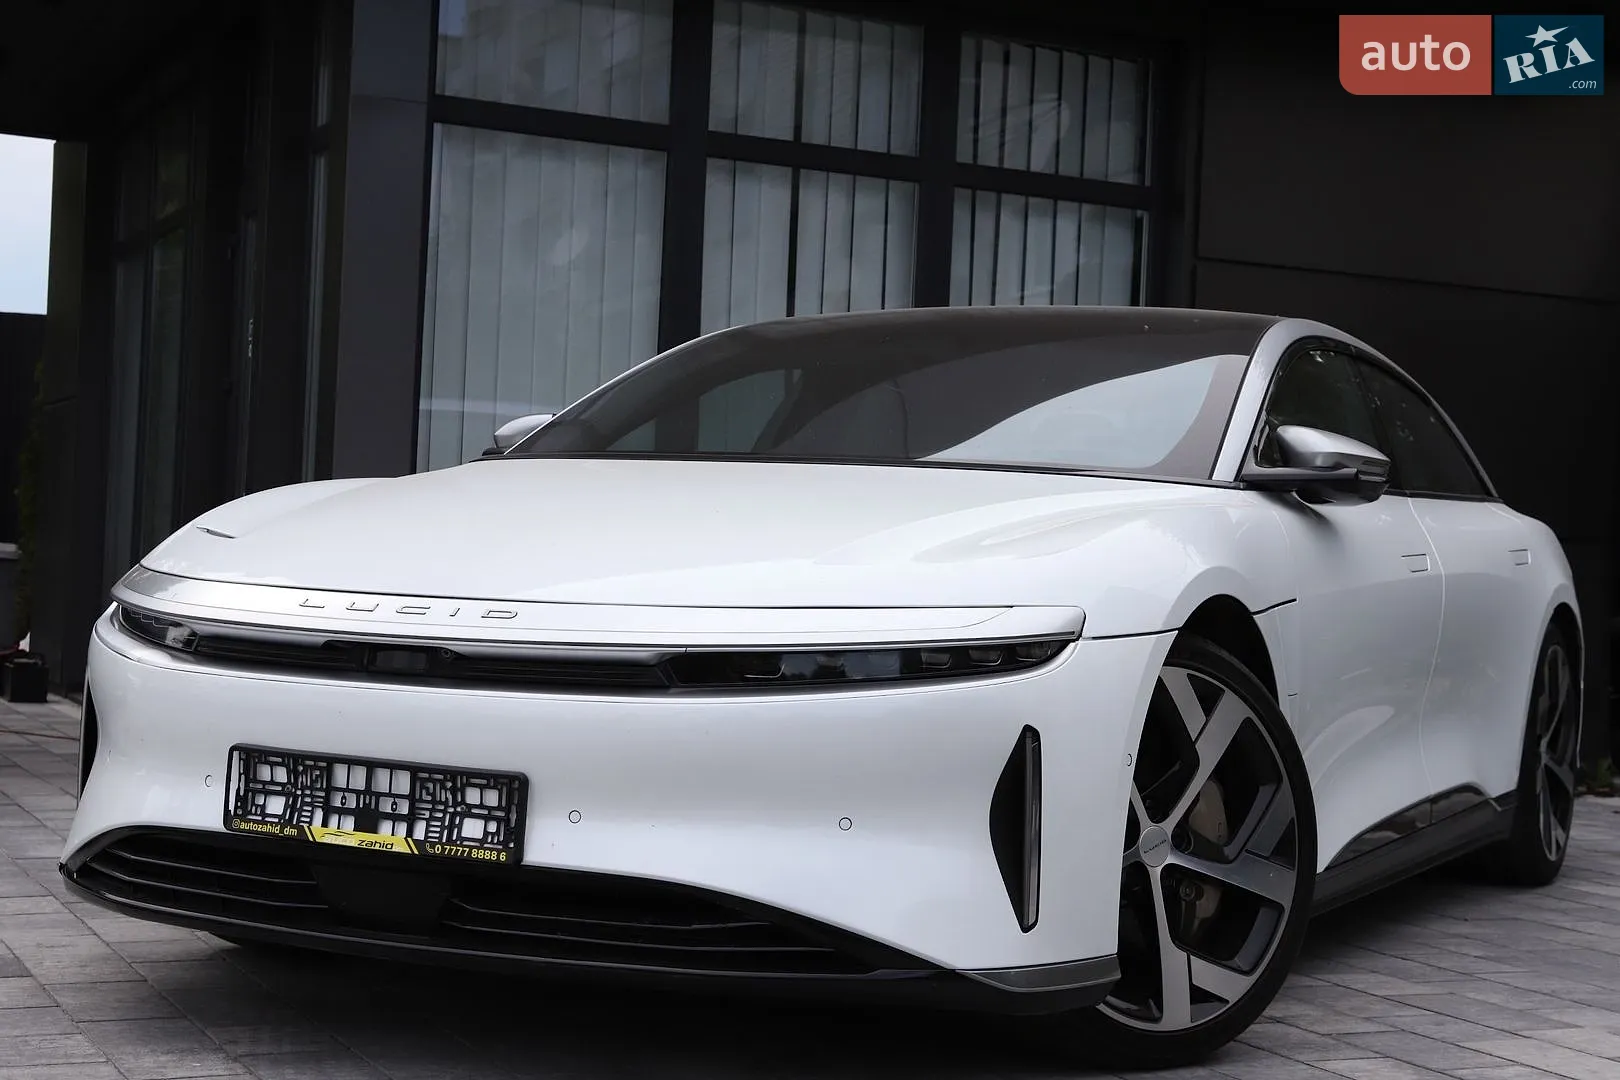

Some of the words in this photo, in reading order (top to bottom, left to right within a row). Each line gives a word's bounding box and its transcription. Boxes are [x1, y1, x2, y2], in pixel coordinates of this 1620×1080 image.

[298, 598, 518, 619] LUCID
[357, 838, 394, 850] zahid
[434, 844, 442, 854] 0
[443, 845, 469, 857] 7777
[471, 848, 498, 861] 8888
[499, 851, 506, 862] 6
